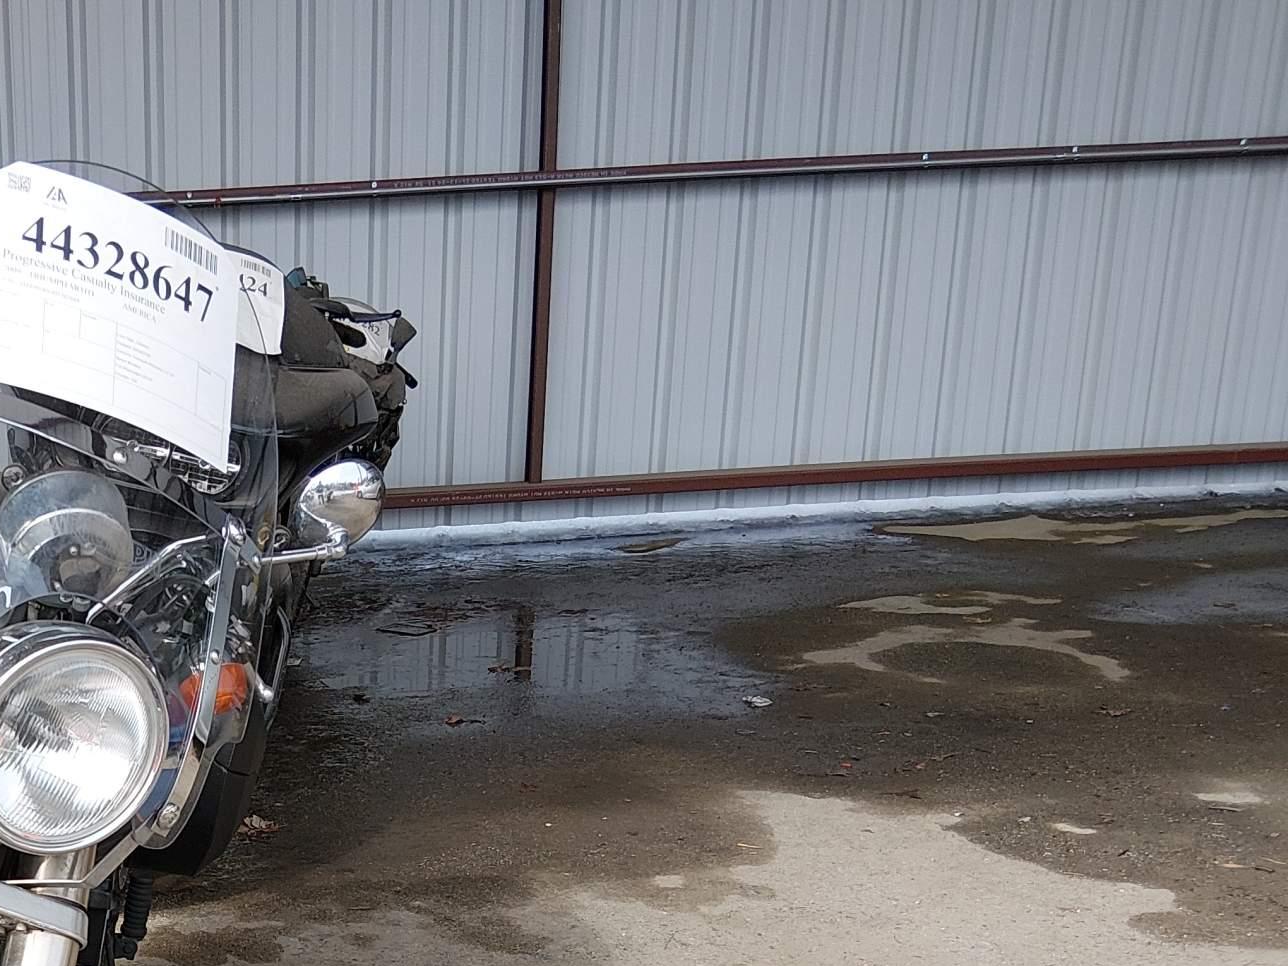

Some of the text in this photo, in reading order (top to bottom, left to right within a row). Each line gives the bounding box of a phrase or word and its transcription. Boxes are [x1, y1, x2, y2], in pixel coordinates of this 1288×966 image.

[3, 247, 69, 276] Progressive
[72, 267, 117, 294] Casualty
[120, 285, 166, 314] Insurance
[21, 216, 214, 322] 44328647
